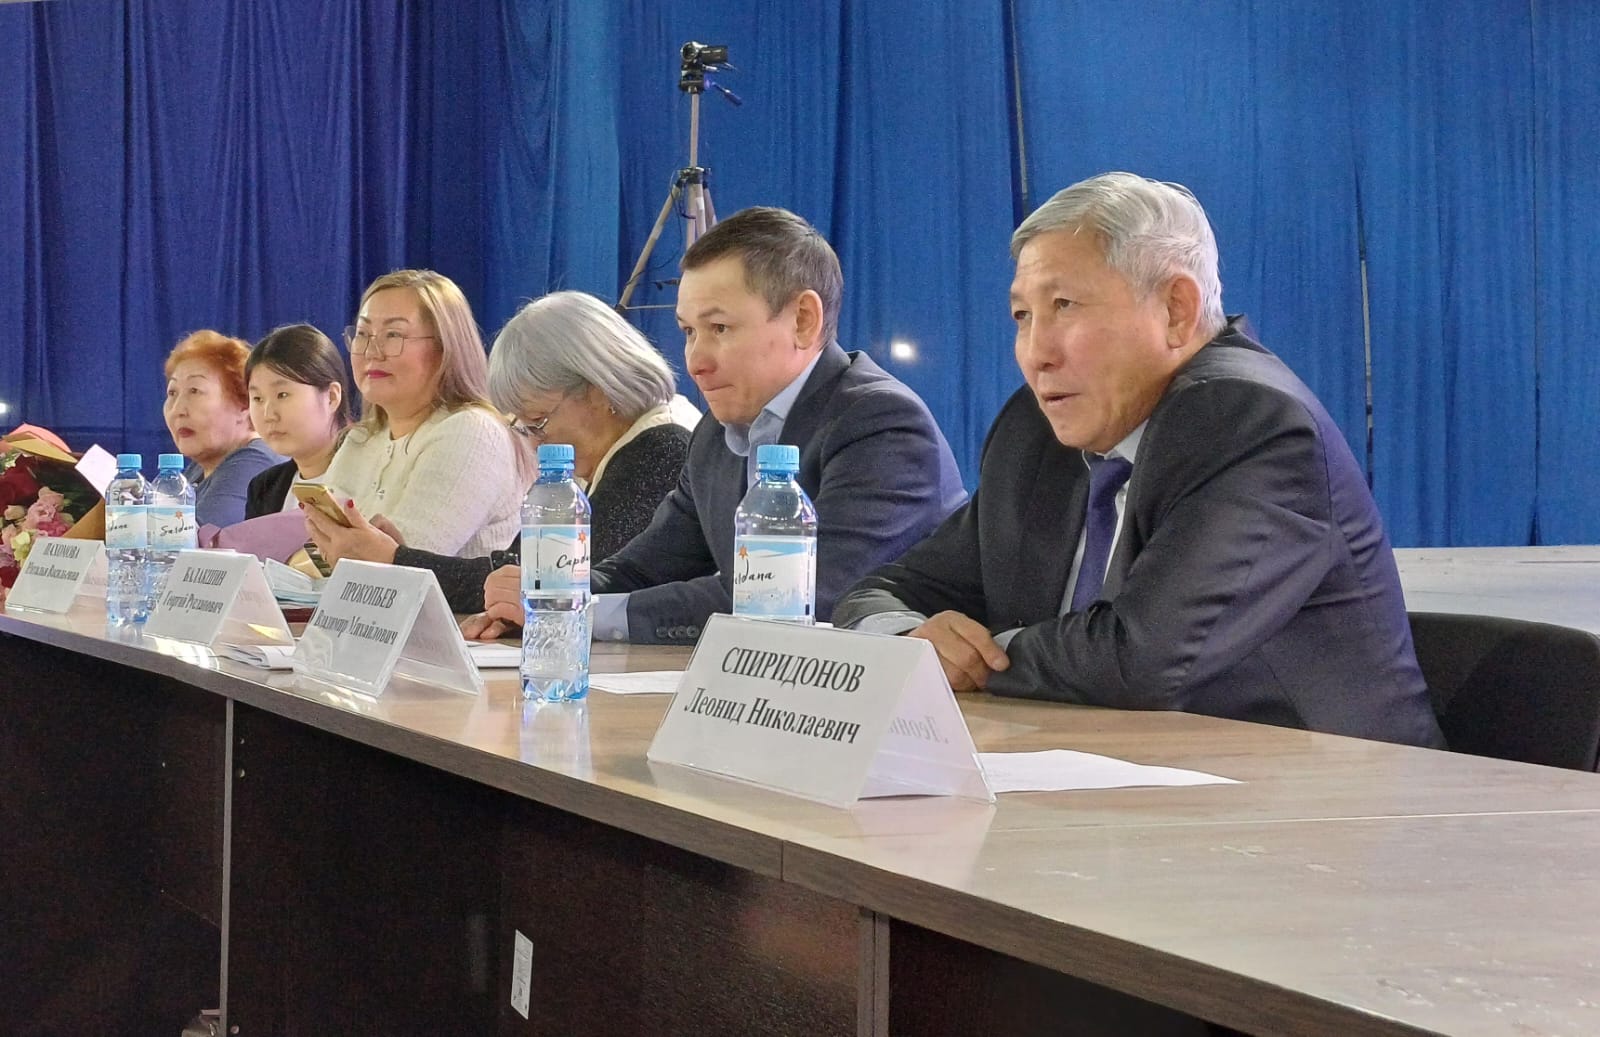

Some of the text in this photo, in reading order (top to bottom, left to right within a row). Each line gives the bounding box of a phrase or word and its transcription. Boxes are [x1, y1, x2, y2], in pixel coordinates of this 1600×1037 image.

[340, 582, 397, 608] ПРОКОПЬЕВ
[350, 615, 398, 645] Михайлович
[722, 646, 865, 692] СПИРИДОНОВ
[684, 687, 861, 744] Леонид Николаевич
